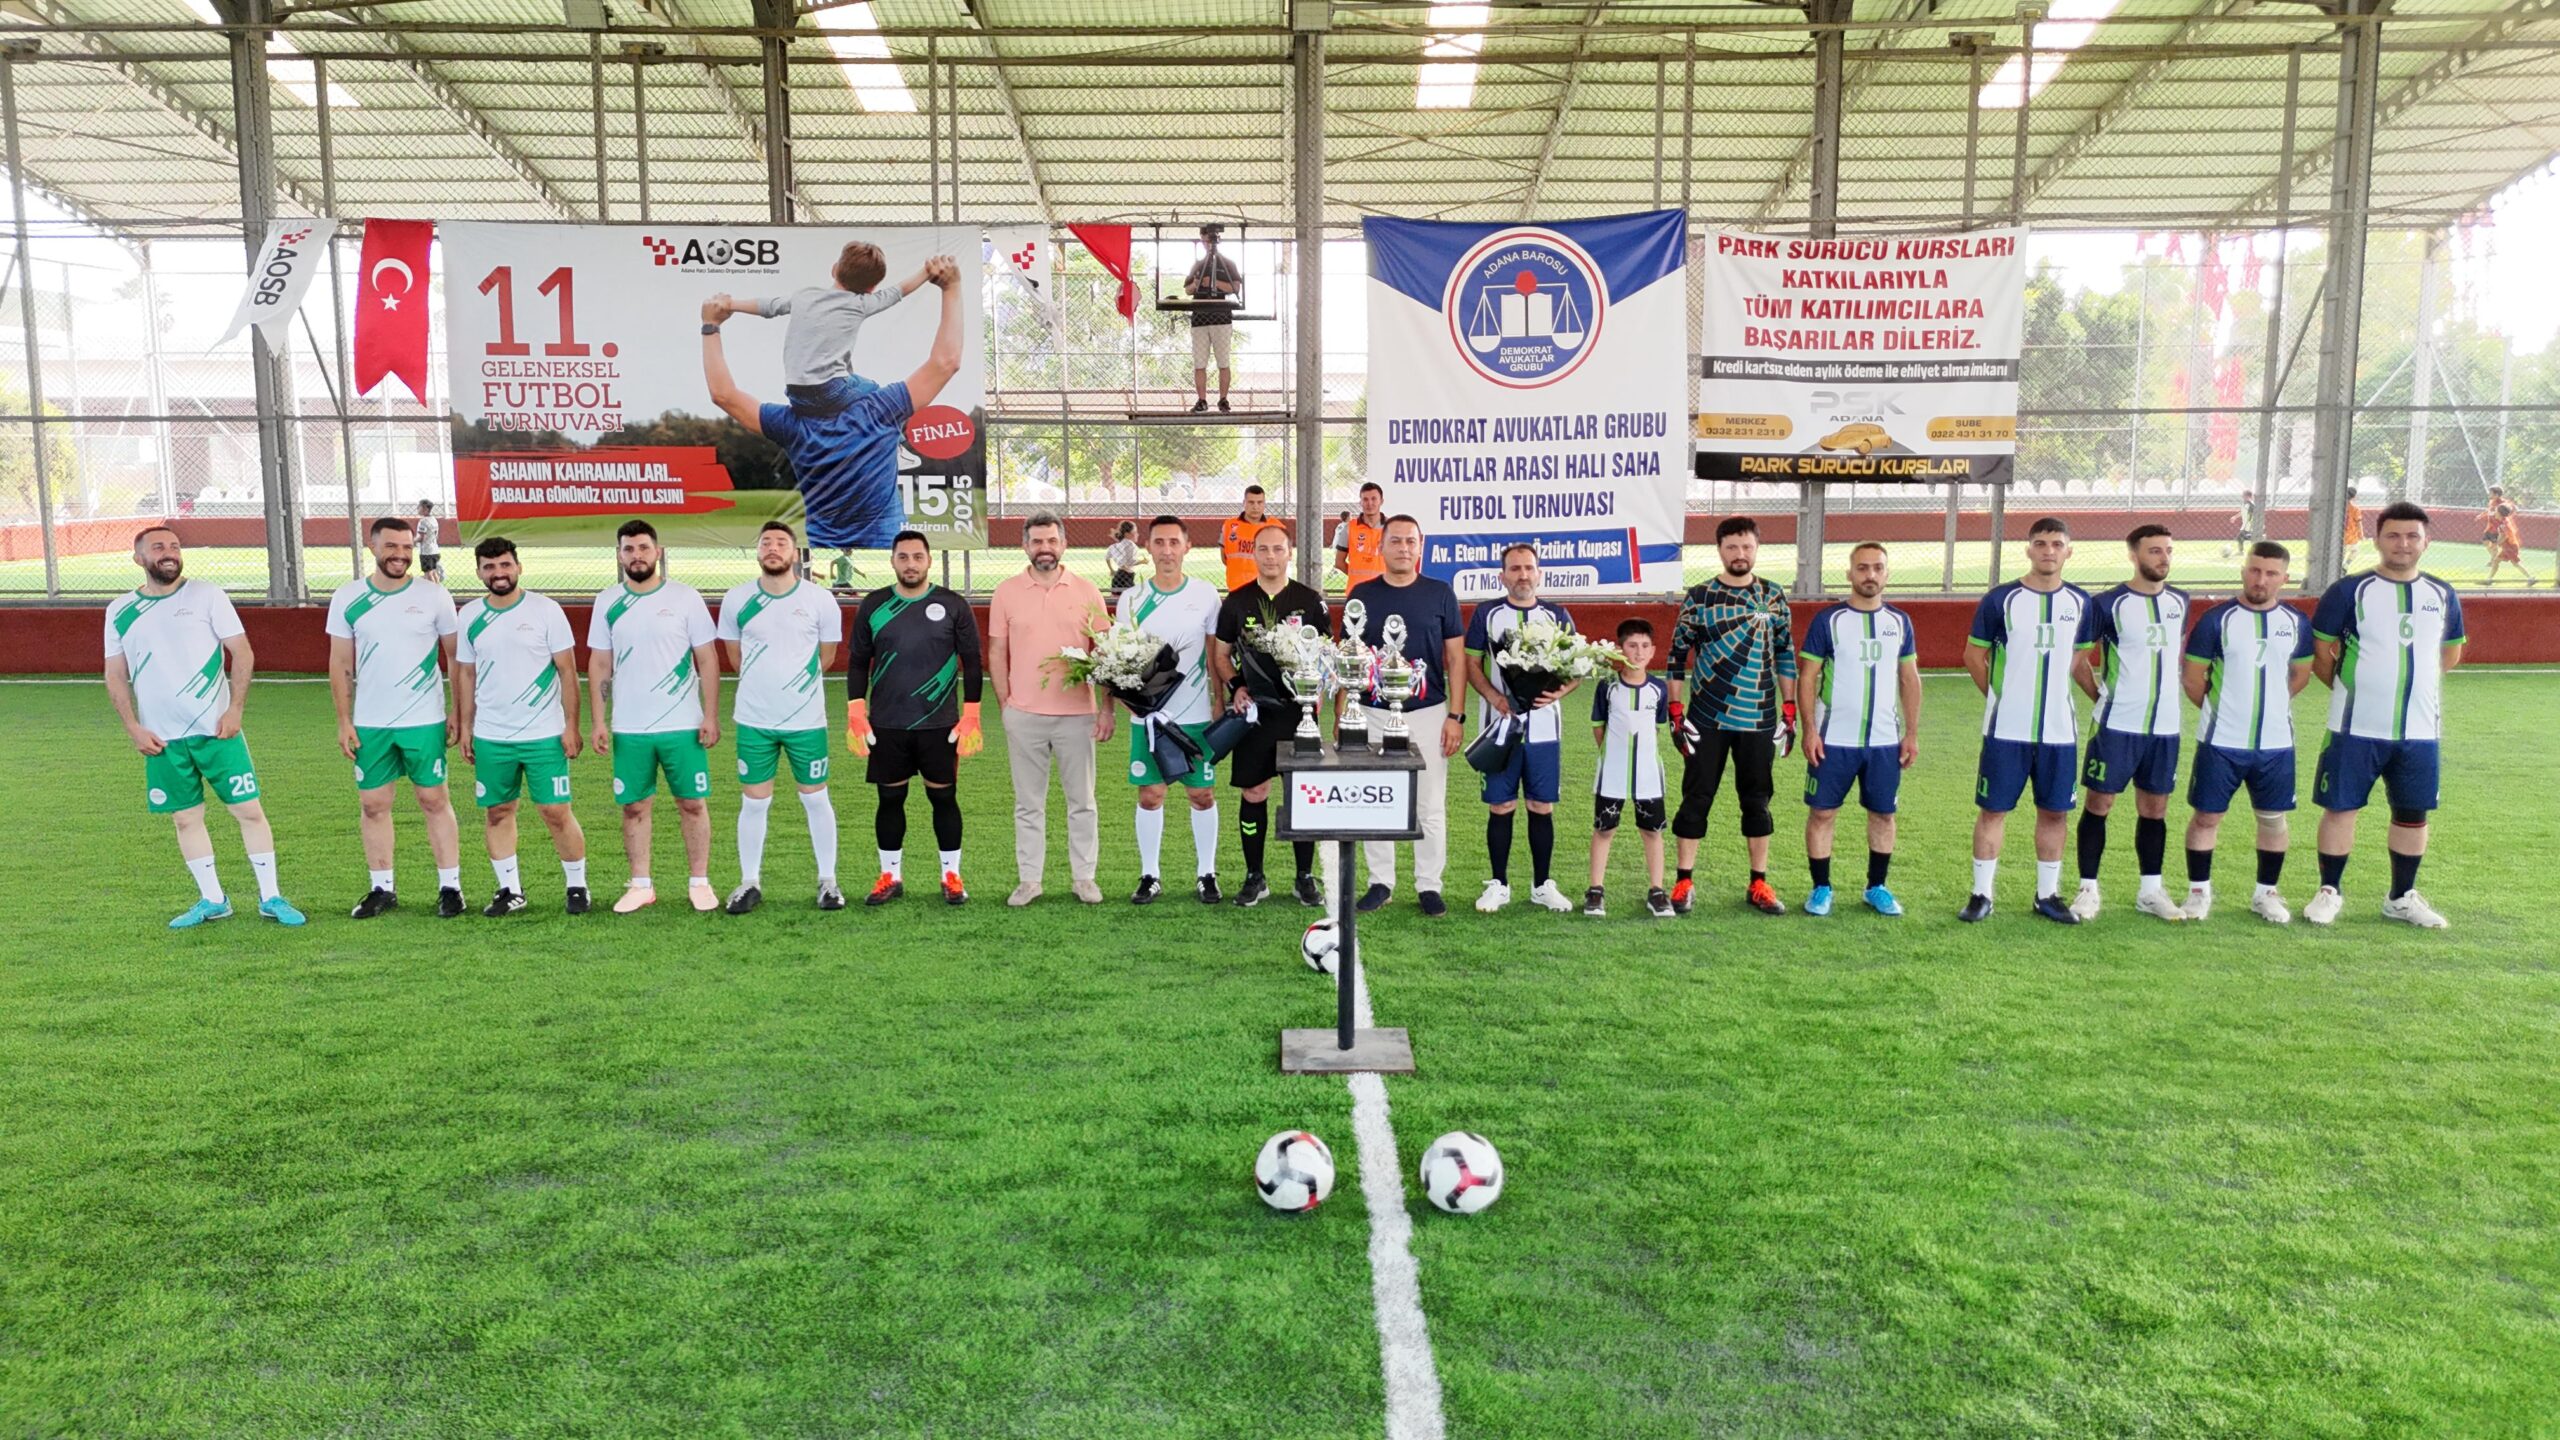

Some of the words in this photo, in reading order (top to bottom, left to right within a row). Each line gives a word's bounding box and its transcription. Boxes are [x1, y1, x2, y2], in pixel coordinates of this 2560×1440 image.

[1718, 236, 1781, 259] PARK
[1896, 236, 2015, 260] KURSLARI
[1484, 252, 1520, 279] ADANA
[1522, 250, 1568, 276] BAROSU
[254, 248, 298, 305] AOSB
[1782, 269, 1948, 290] KATKILARIYLA
[477, 266, 619, 358] 11.
[1743, 294, 1792, 319] TÜM
[1800, 298, 1984, 320] KATILIMCILARA
[1744, 326, 1875, 351] BAŞARILAR
[1883, 325, 1981, 350] DİLERİZ.
[1499, 354, 1554, 364] AVUKATLAR
[1501, 346, 1553, 355] DEMOKRAT
[481, 361, 620, 378] GELENEKSEL
[1509, 363, 1544, 372] GRUBU
[1713, 360, 1743, 374] Kredi
[1784, 363, 1813, 377] elden
[1815, 364, 1842, 380] aylık
[1845, 364, 1883, 378] ödeme
[1885, 364, 1899, 378] ile
[1901, 364, 1940, 379] ehliyet
[1942, 364, 1969, 377] alma
[1970, 362, 2008, 377] imkanı
[482, 382, 621, 409] FUTBOL
[1810, 391, 1906, 415] PSK
[484, 412, 624, 432] TURNUVASI
[1389, 418, 1487, 445] DEMOKRAT
[1493, 415, 1598, 443] AVUKATLAR
[1604, 412, 1667, 439] GRUBU
[1725, 417, 1767, 425] MERKEZ
[1830, 415, 1884, 423] ADANA
[912, 421, 970, 443] FİNAL
[489, 462, 552, 481] SAHANIN
[1394, 457, 1497, 483] AVUKATLAR
[1503, 454, 1558, 482] ARASI
[1566, 453, 1605, 479] HALI
[1612, 451, 1660, 477] SAHA
[1740, 456, 1793, 473] PARK
[1798, 455, 1875, 475] SÜRÜCÜ
[1880, 458, 1970, 475] KURSLARI
[491, 487, 545, 503] BABALAR
[546, 485, 601, 504] GÜNÜNÜZ
[602, 488, 641, 504] KUTLU
[897, 475, 948, 516] 15
[953, 475, 973, 534] 2025
[1440, 495, 1507, 521] FUTBOL
[1512, 491, 1614, 519] TURNUVASI
[900, 521, 949, 532] Haziran
[1431, 545, 1452, 563] Av.
[1455, 543, 1487, 562] Etem
[1533, 538, 1576, 560] Öztürk
[1578, 540, 1622, 560] Kupası
[1463, 575, 1476, 591] 17
[1480, 573, 1503, 591] May
[1544, 572, 1589, 588] Haziran
[2421, 604, 2439, 613] ADM
[2033, 625, 2055, 648] 11
[2146, 625, 2168, 646] 21
[2274, 630, 2292, 638] ADM
[2400, 615, 2413, 639] 6
[1859, 640, 1882, 662] 10
[2255, 640, 2267, 662] 7
[433, 758, 442, 777] 4
[810, 757, 828, 779] 87
[1203, 762, 1213, 781] 5
[2087, 759, 2106, 781] 21
[229, 772, 255, 797] 26
[552, 776, 569, 796] 10
[695, 772, 707, 792] 9
[2320, 771, 2329, 793] 6
